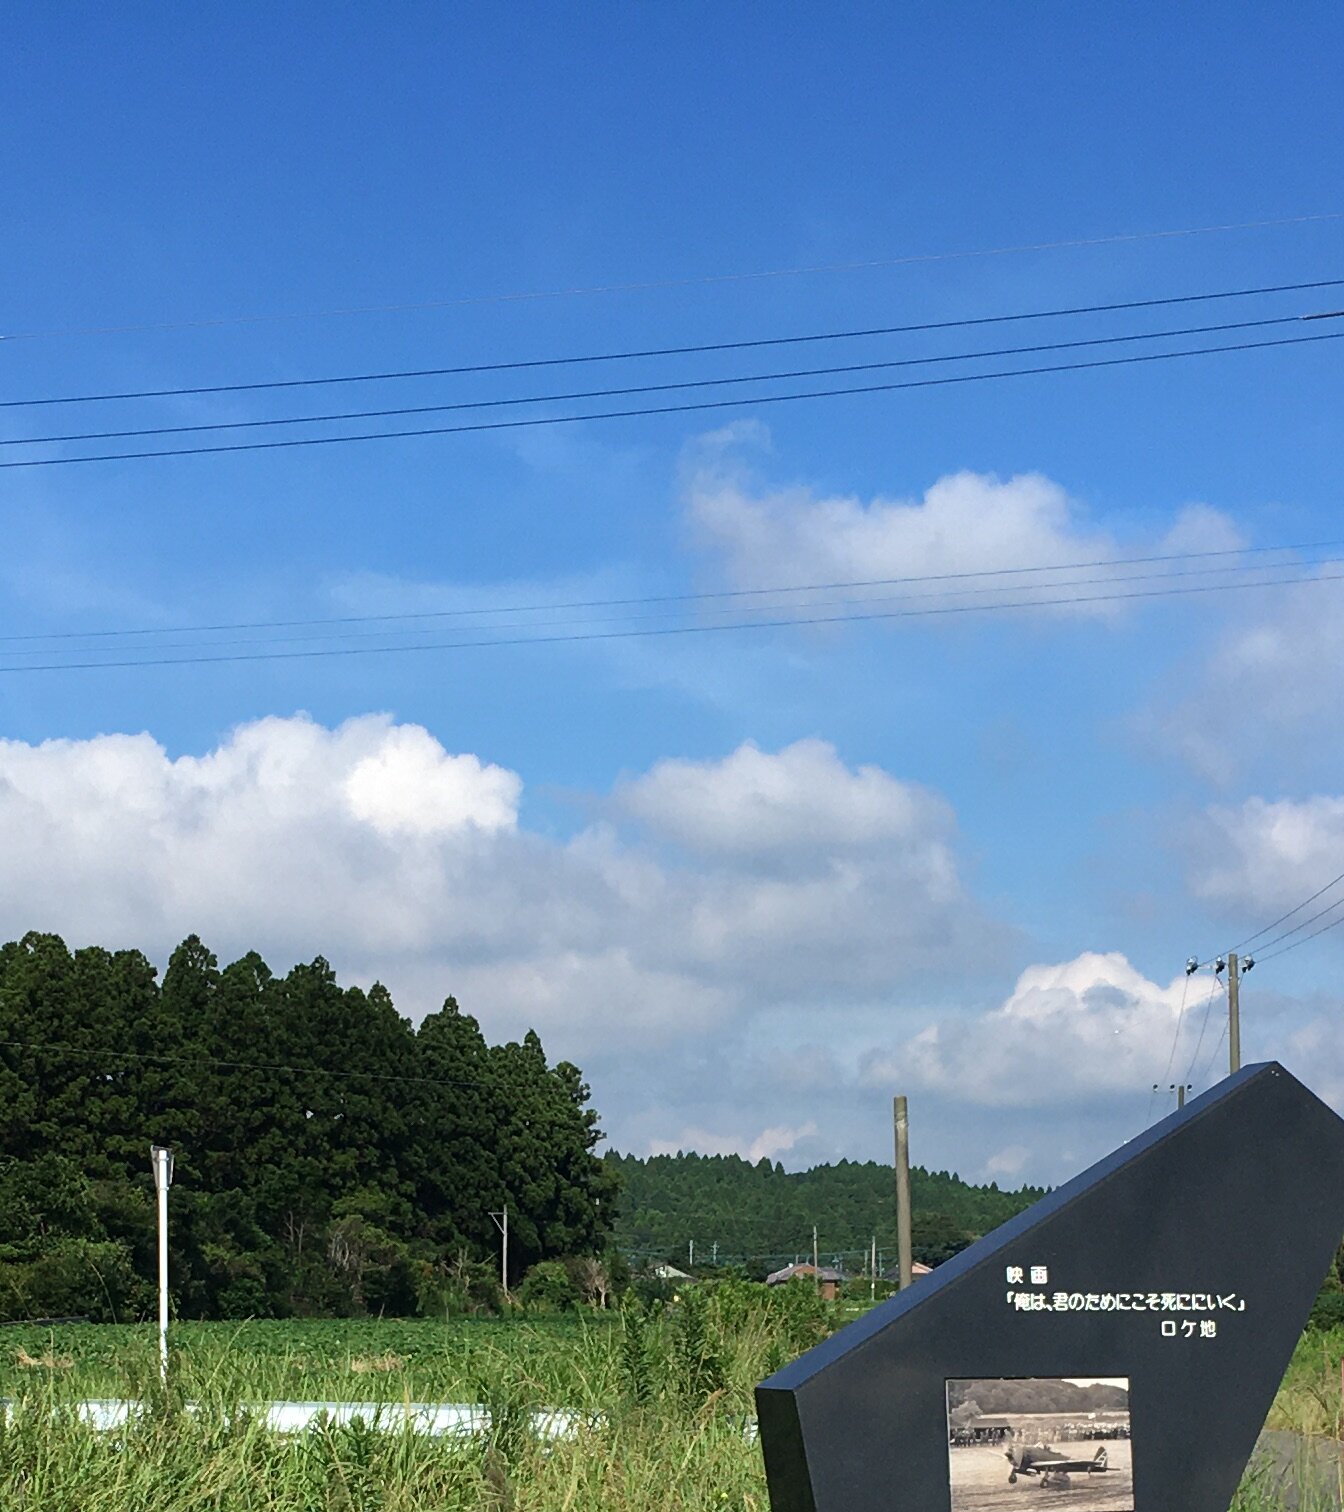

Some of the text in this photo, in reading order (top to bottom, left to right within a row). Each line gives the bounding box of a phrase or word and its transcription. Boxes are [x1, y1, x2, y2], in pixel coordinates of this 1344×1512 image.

[1006, 1266, 1048, 1285] 映画
[1161, 1320, 1217, 1338] ロケ地
